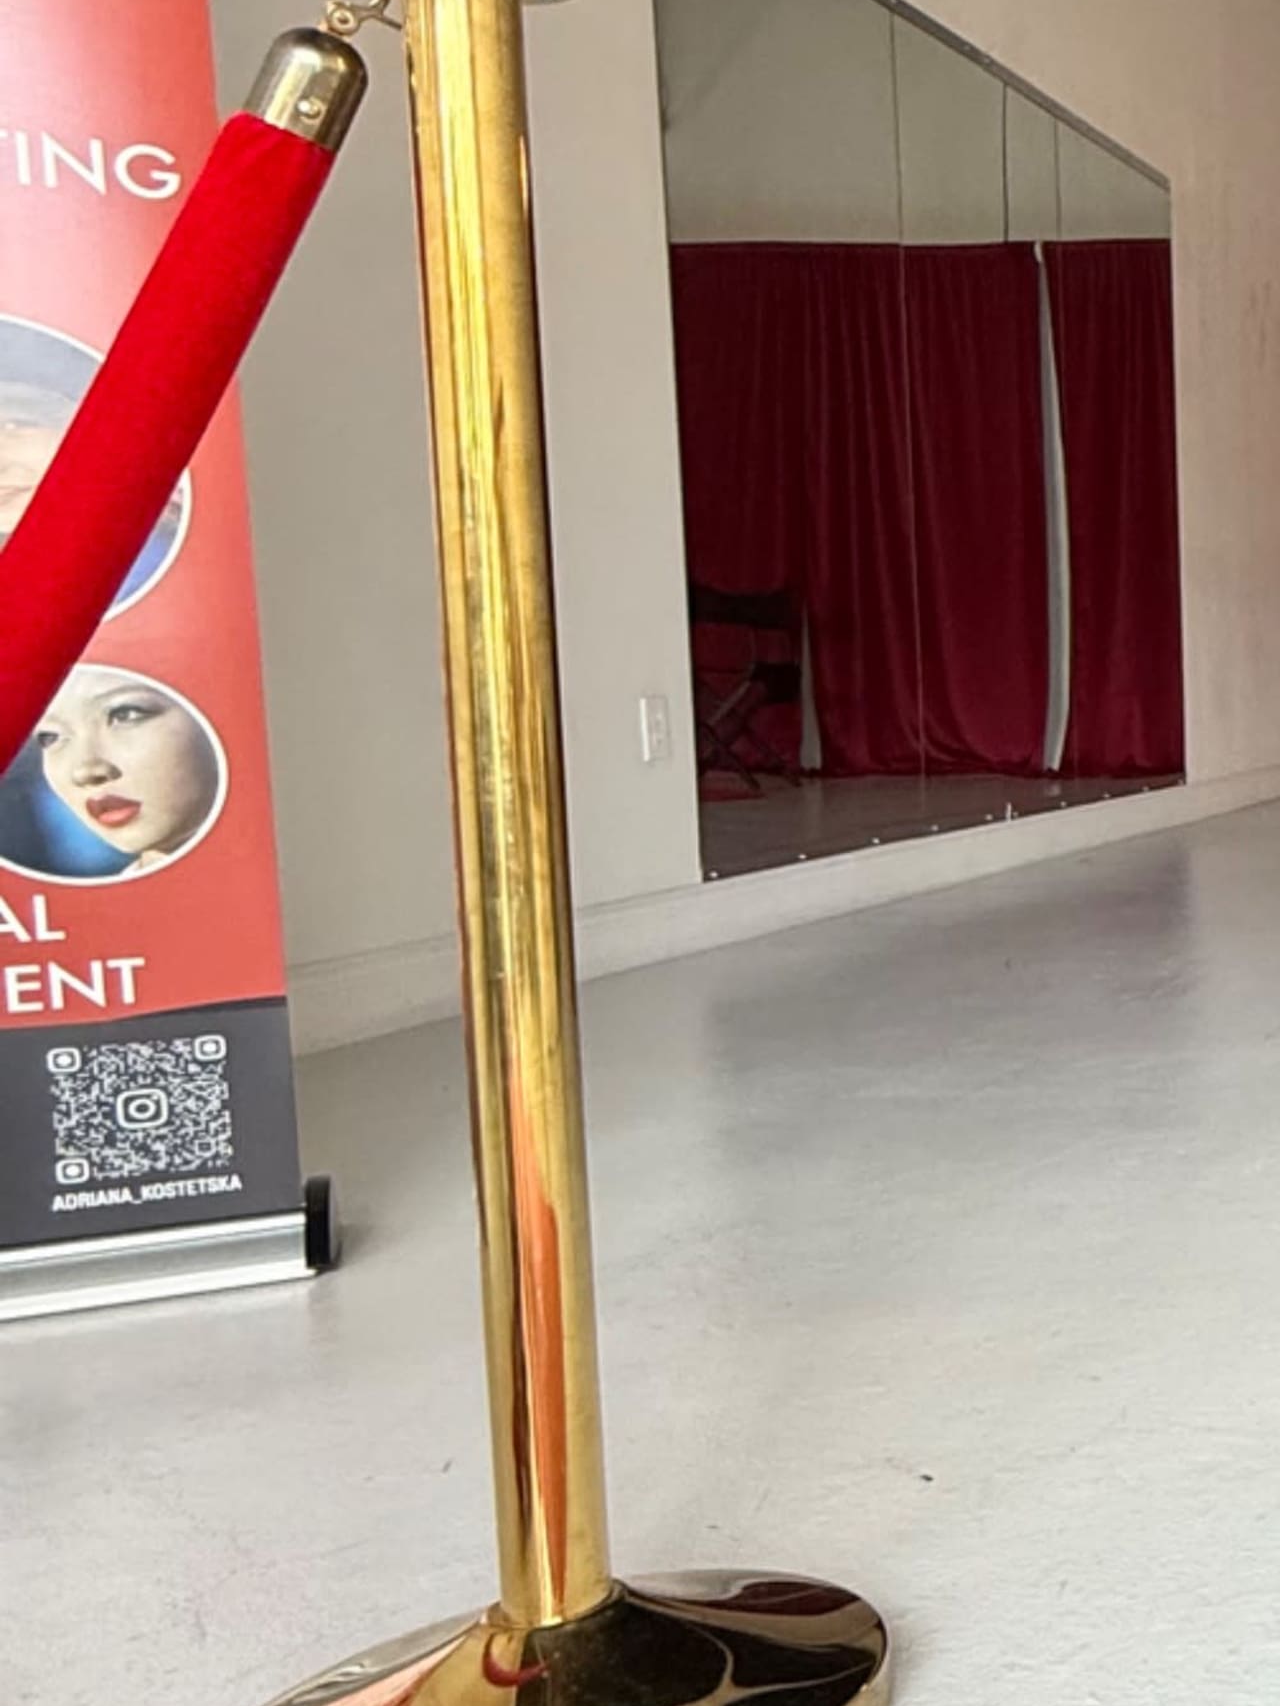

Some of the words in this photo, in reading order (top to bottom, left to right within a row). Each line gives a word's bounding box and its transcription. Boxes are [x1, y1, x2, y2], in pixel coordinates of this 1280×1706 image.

[0, 127, 181, 199] ING
[4, 956, 146, 1014] ENT
[52, 1174, 243, 1212] ADRIANA_KOSTETSKA
